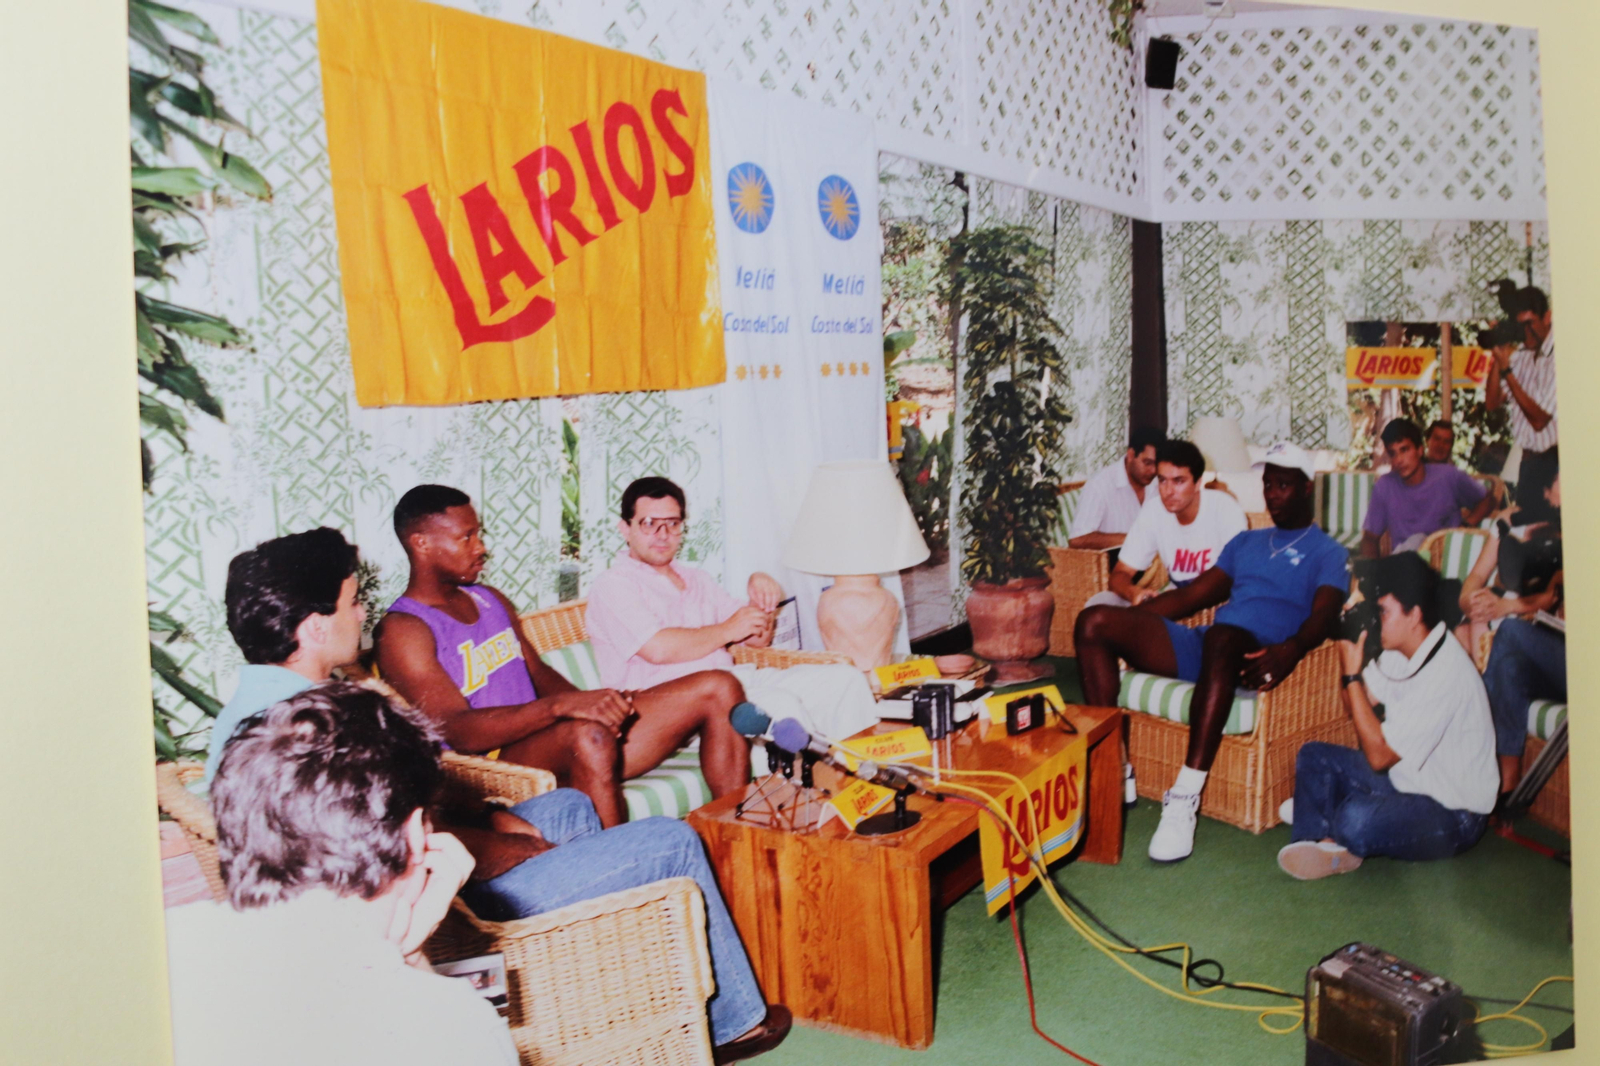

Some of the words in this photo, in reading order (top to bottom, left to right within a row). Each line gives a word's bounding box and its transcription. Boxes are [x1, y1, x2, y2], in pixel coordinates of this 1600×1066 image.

[402, 87, 696, 352] LARIOS
[770, 315, 791, 334] Sol
[811, 314, 841, 334] Costa
[843, 316, 858, 334] del
[859, 316, 874, 334] Sol
[1354, 349, 1425, 385] LARIOS
[1002, 763, 1079, 877] LARIOS
